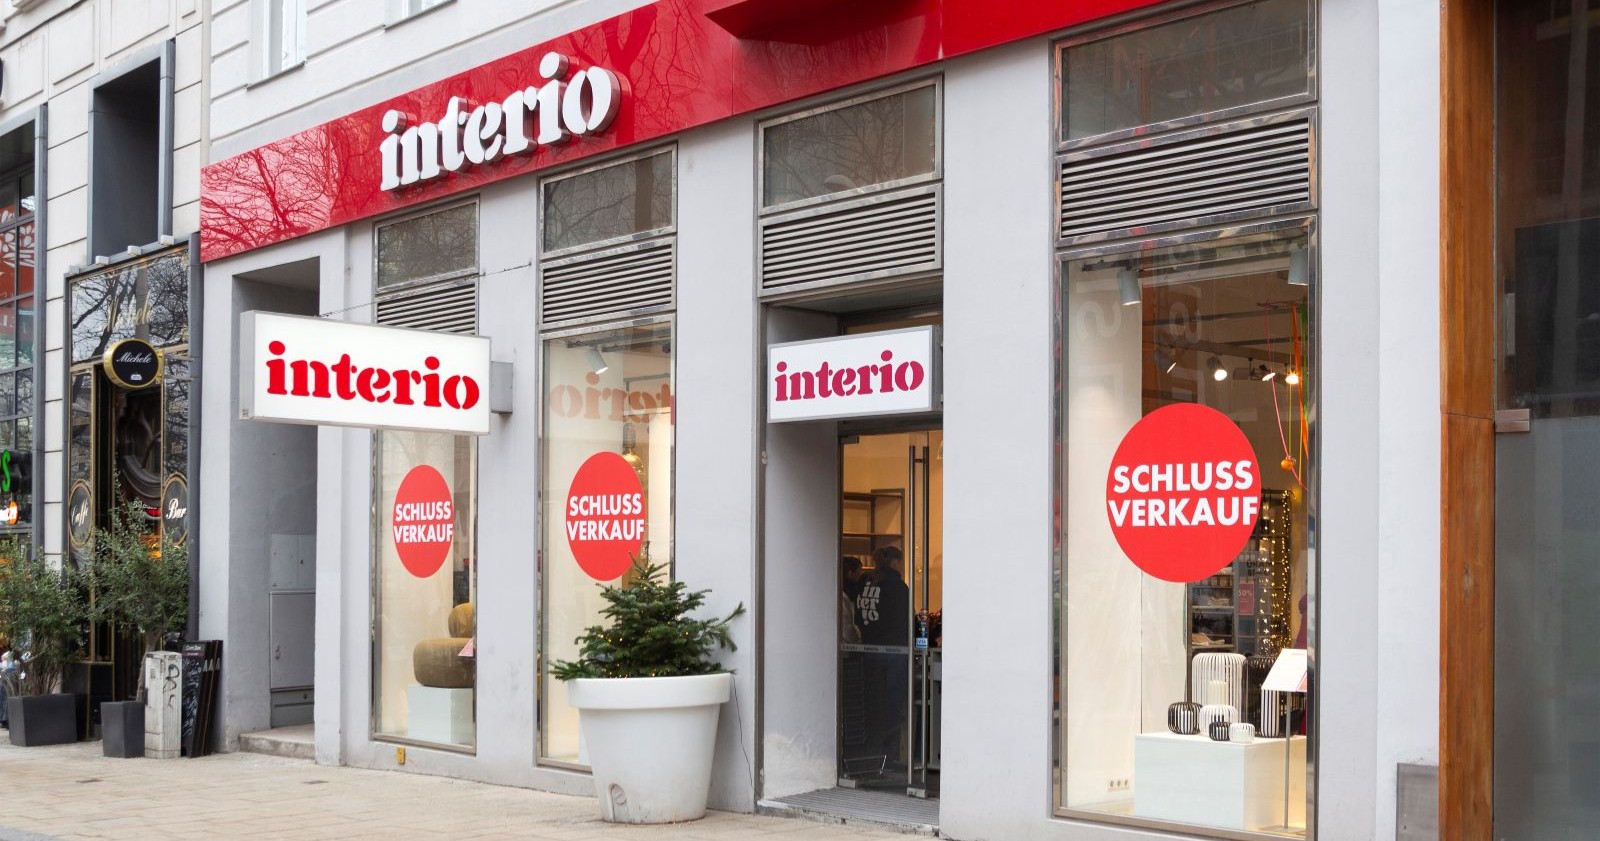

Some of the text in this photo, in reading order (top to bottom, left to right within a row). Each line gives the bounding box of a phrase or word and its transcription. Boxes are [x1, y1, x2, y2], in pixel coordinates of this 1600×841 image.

[380, 52, 620, 191] interio
[117, 352, 152, 364] Michele
[266, 341, 480, 410] interio
[775, 350, 925, 402] interio
[1113, 460, 1254, 493] SCHLUSS
[165, 498, 187, 520] Bar
[395, 501, 452, 522] SCHLUSS
[569, 493, 643, 517] SCHLUSS
[1108, 496, 1259, 527] VERKAUF
[393, 523, 454, 544] VERKAUF
[566, 519, 645, 541] VERKAUF
